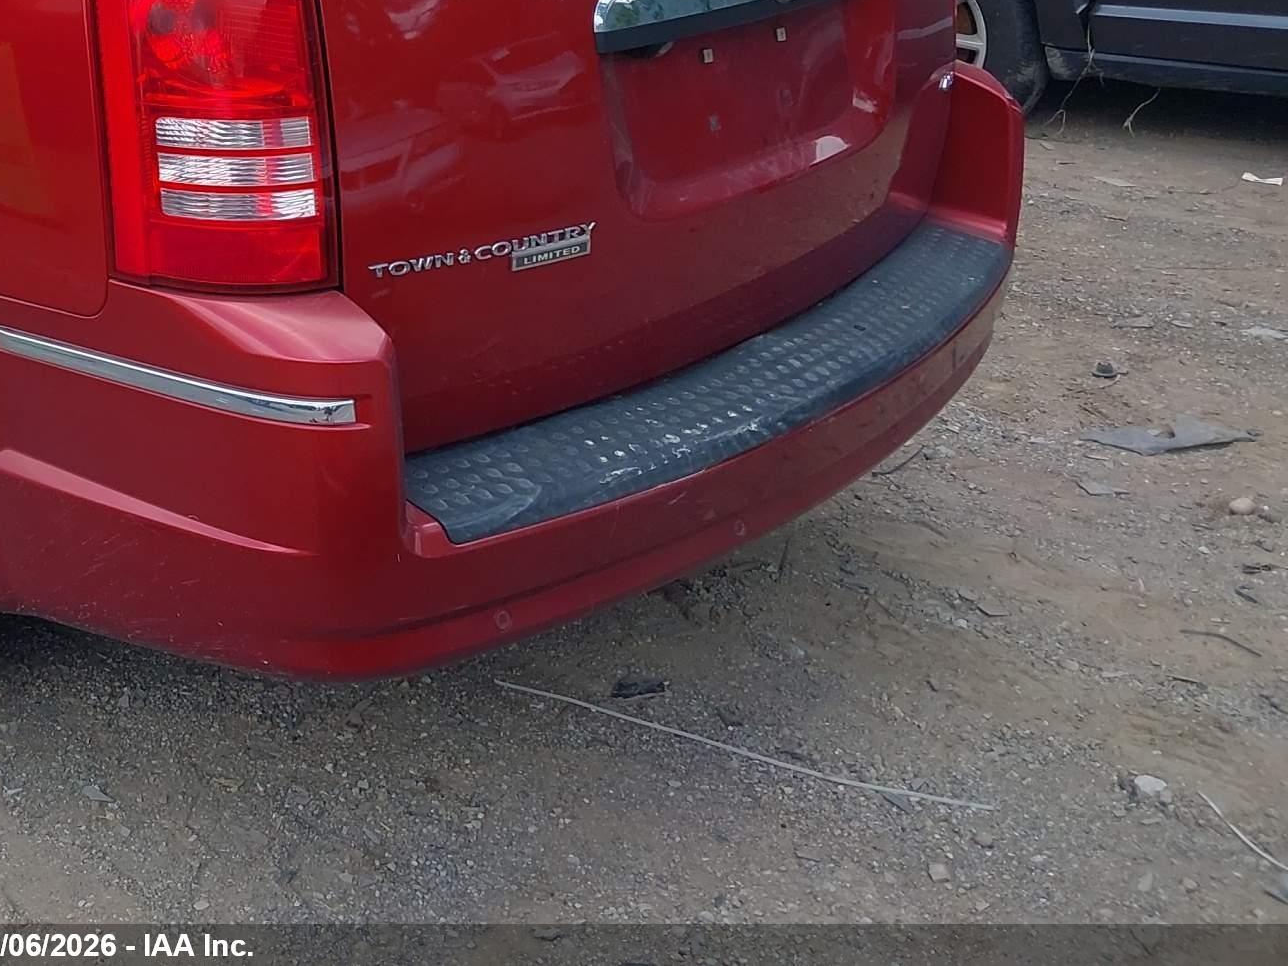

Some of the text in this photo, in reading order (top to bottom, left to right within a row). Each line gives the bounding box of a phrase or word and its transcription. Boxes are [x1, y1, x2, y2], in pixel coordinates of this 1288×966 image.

[367, 221, 597, 279] TOWN & COUNTRY
[523, 244, 582, 266] LIMITED
